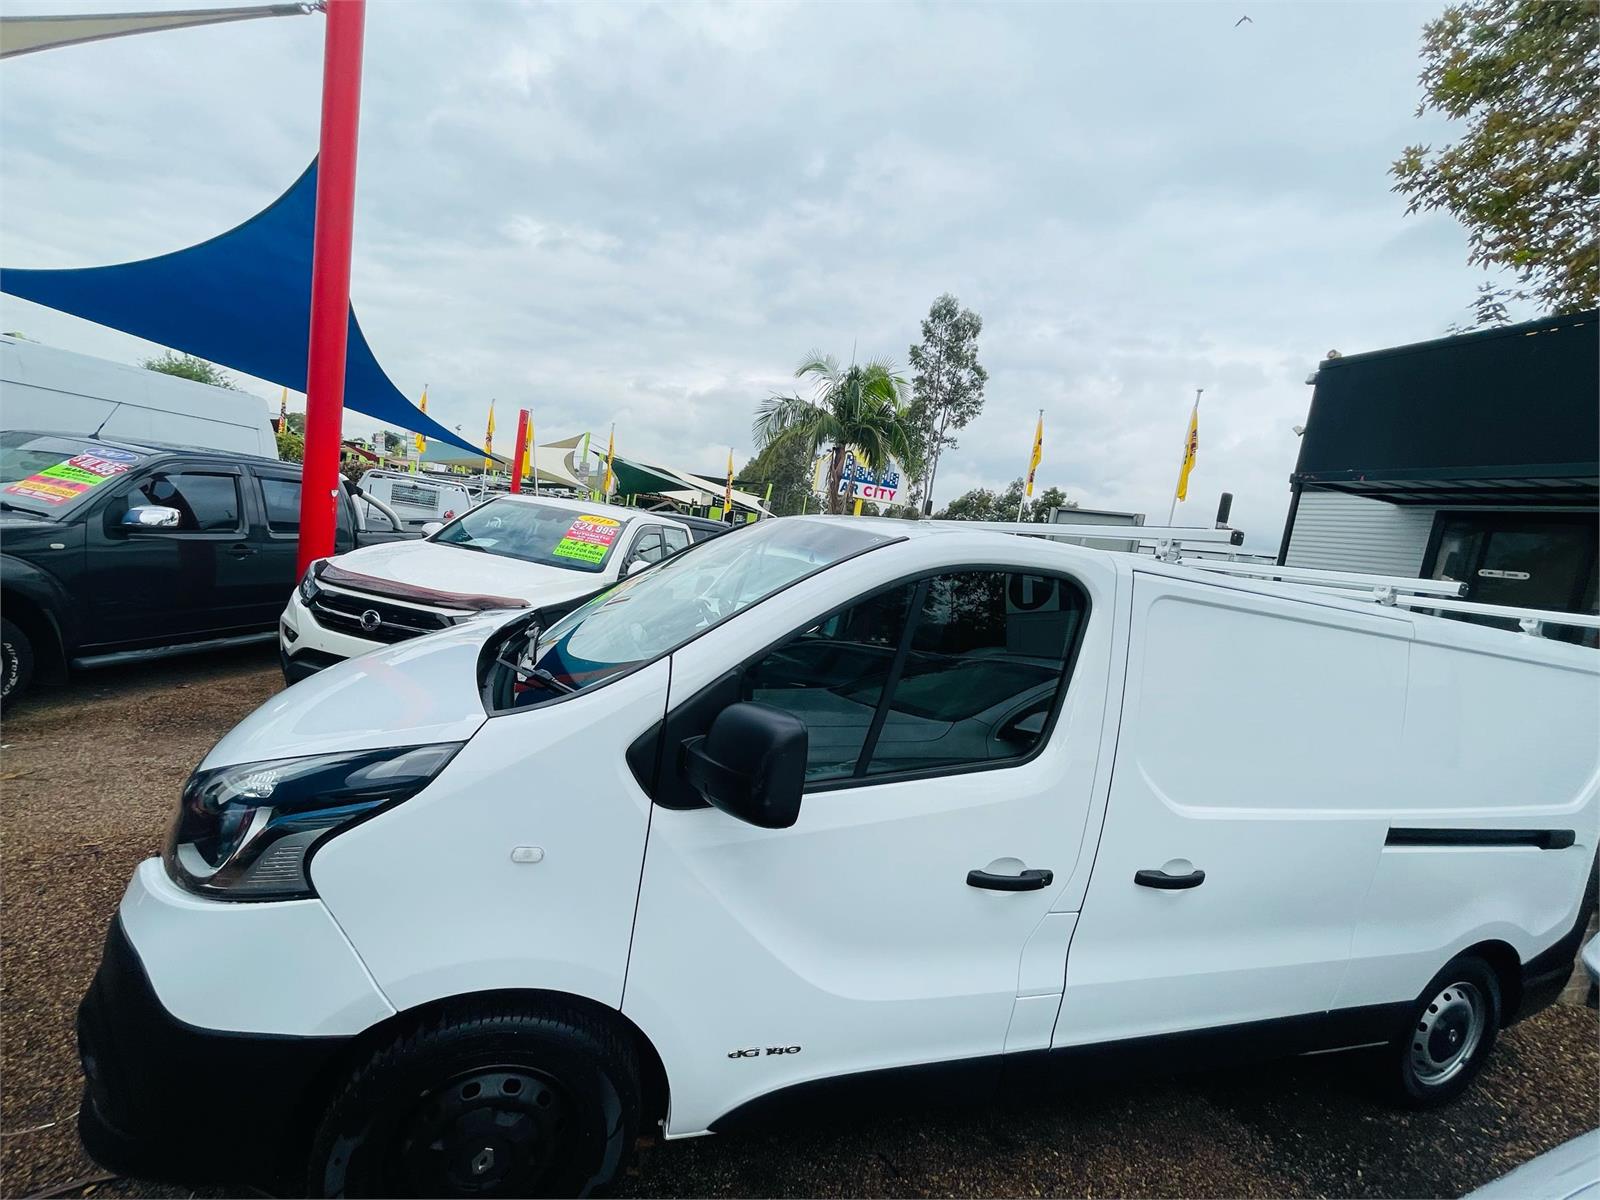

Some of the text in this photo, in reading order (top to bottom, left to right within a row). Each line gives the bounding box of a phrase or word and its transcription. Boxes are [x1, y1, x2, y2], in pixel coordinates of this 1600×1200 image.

[863, 486, 897, 501] CITY
[573, 521, 616, 536] $24,995
[572, 530, 610, 541] AUTOMATIC
[588, 549, 603, 557] WORK
